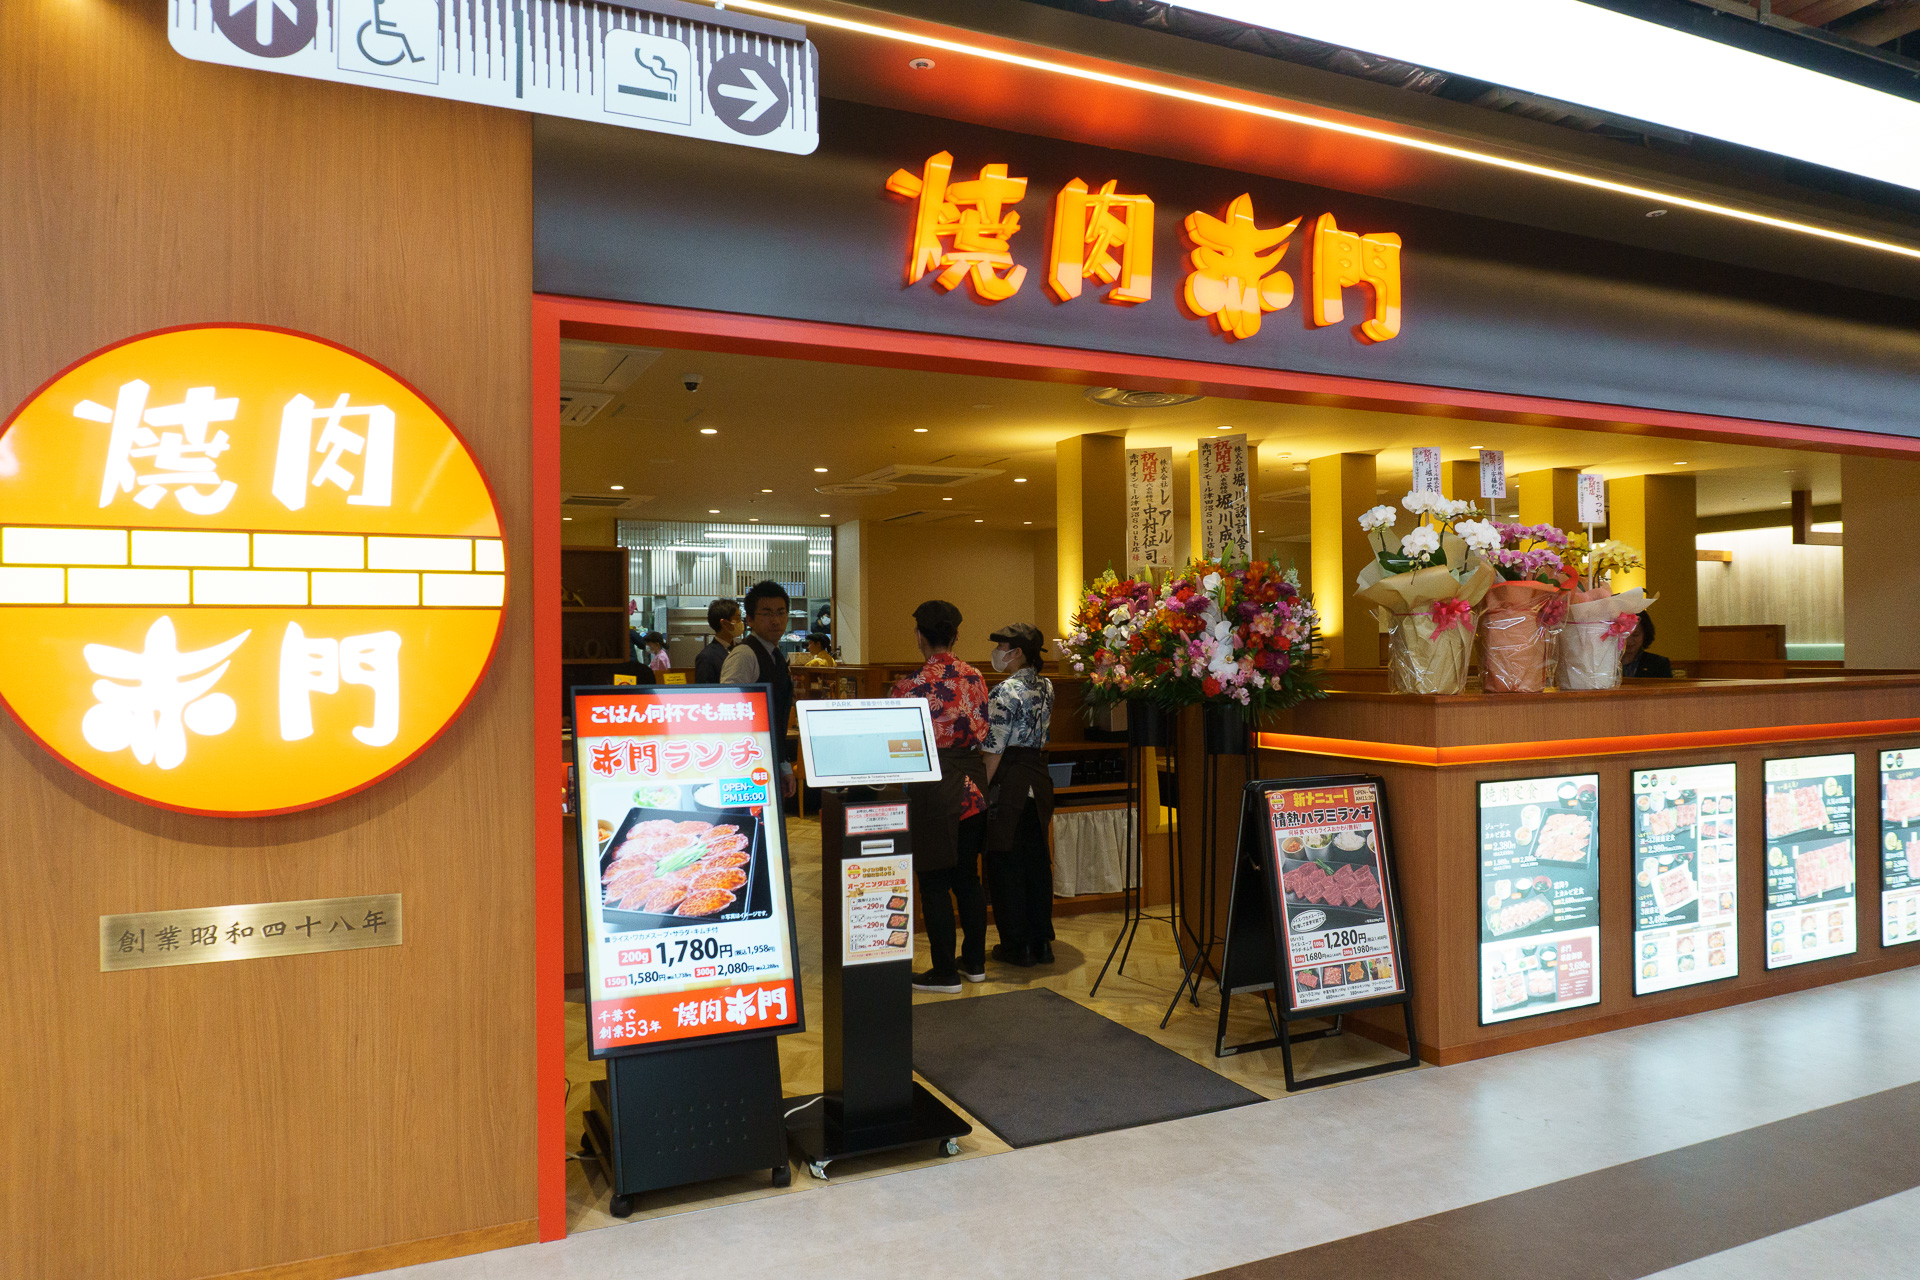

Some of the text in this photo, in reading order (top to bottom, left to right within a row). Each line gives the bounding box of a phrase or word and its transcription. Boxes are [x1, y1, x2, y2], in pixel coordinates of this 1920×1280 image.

[1140, 450, 1159, 483] 祝開店
[1213, 439, 1233, 474] 祝開店
[81, 615, 402, 770] 赤門
[590, 701, 755, 724] ごはん何杯でも無料
[590, 738, 763, 777] 赤門ランチ
[723, 792, 765, 803] PM16:00
[1272, 805, 1372, 828] 情熱ハラミランチ
[117, 909, 387, 955] 創業昭和四十八年
[1324, 929, 1367, 950] 1,280円
[620, 951, 650, 966] 200g
[656, 937, 732, 968] 1,780円
[606, 977, 626, 987] 150g
[628, 971, 666, 986] 1,580円
[696, 967, 715, 977] 300g
[717, 962, 755, 977] 2,080円
[598, 1008, 637, 1024] 千葉で
[599, 1019, 662, 1040] 創業53年
